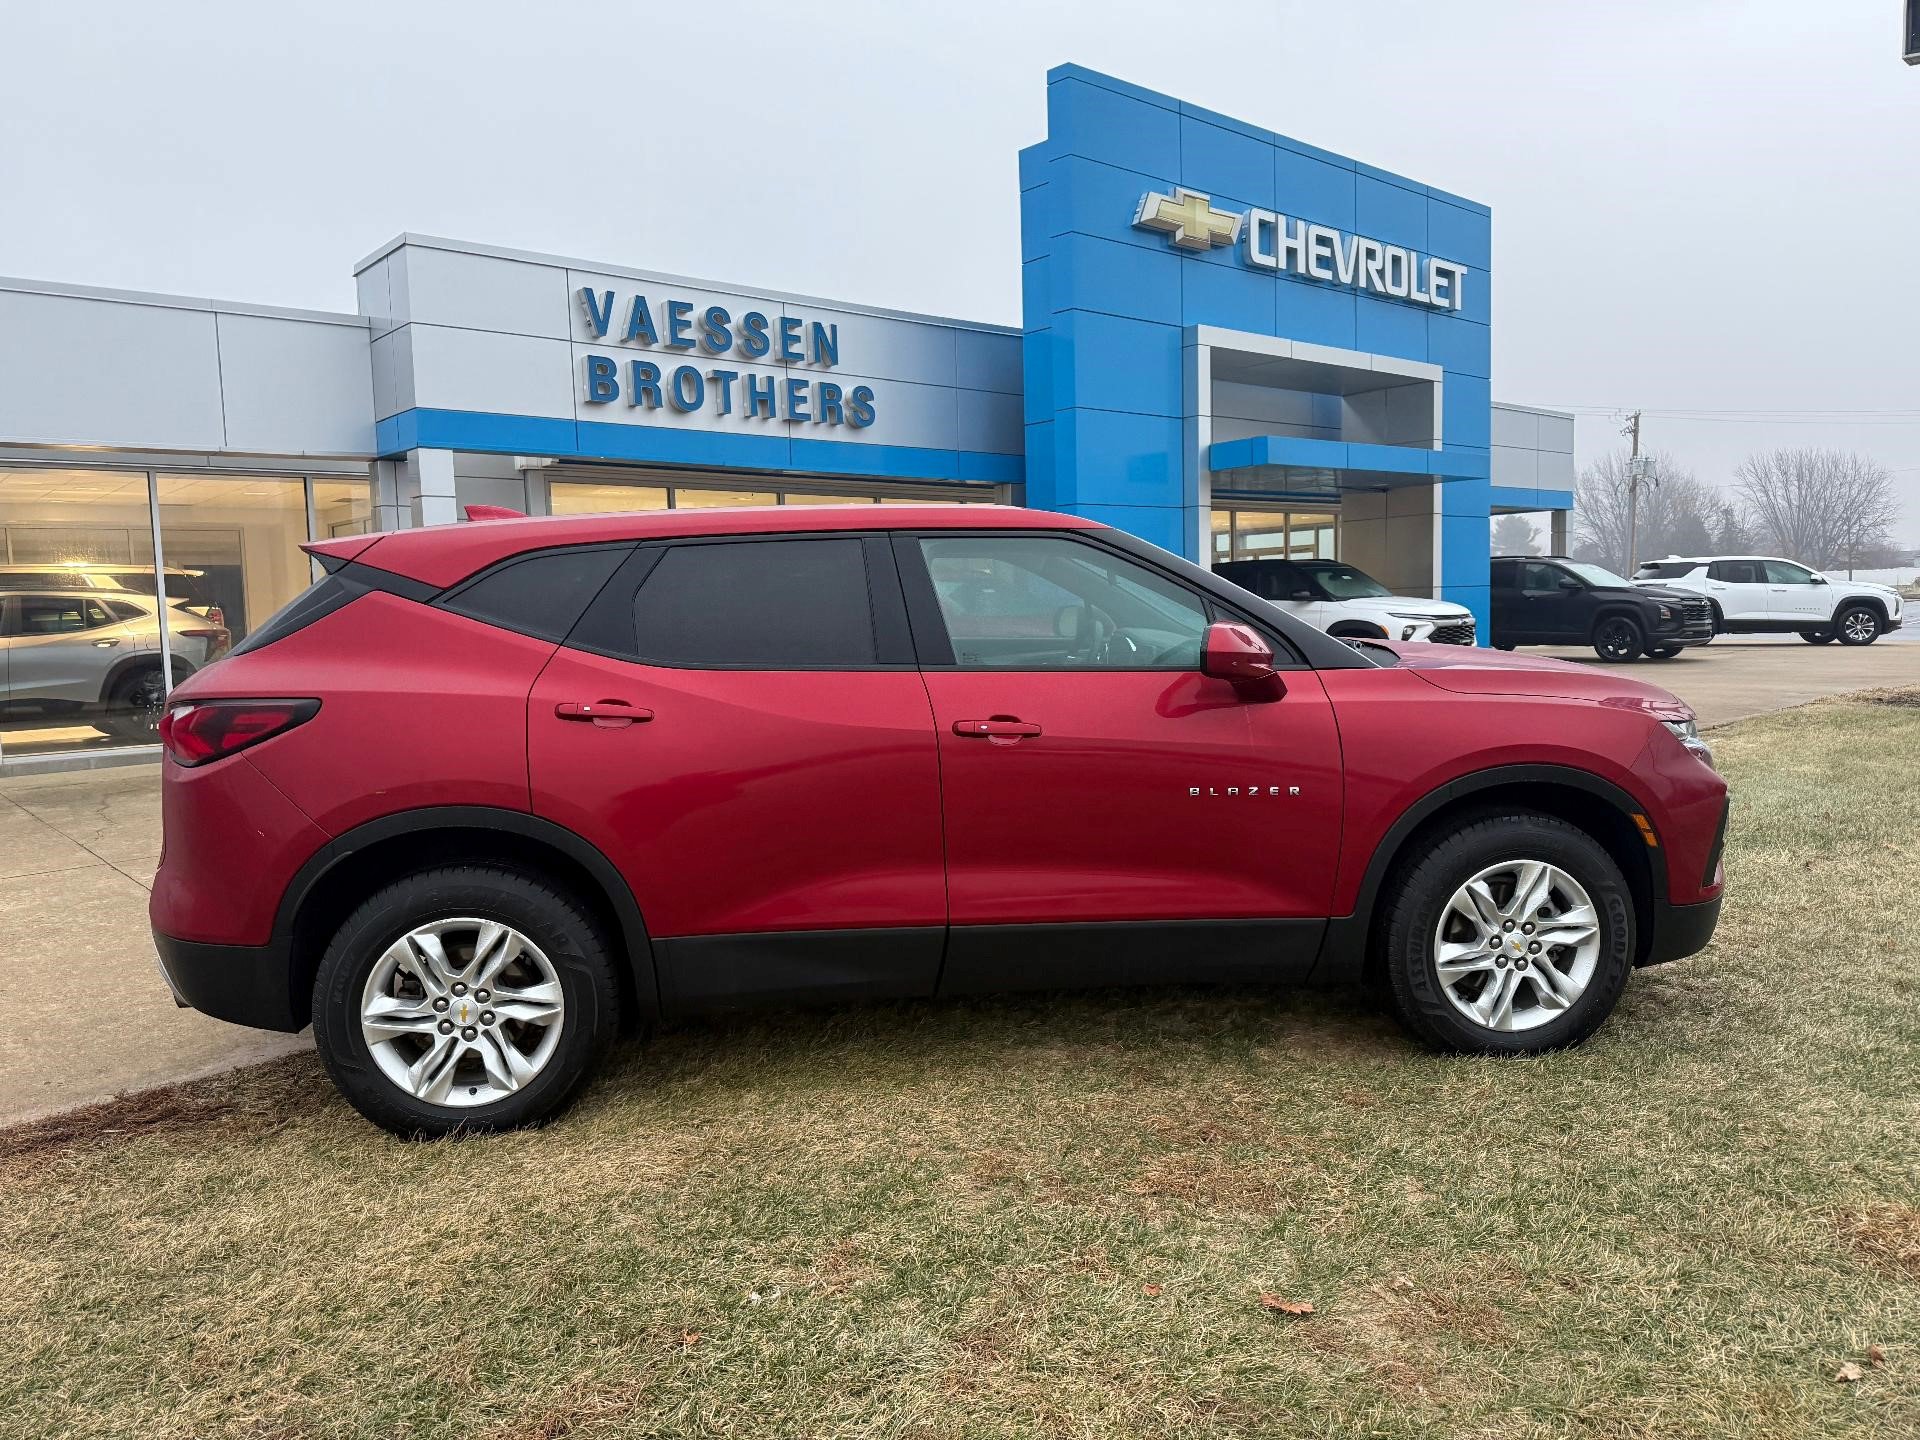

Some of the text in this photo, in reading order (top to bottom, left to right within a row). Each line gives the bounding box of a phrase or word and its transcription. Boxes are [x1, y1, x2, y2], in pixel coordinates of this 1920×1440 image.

[1247, 207, 1467, 311] CHEVROLET
[578, 287, 839, 367] VAESSEN
[582, 355, 876, 428] BROTHERS
[1189, 786, 1300, 796] BLAZER
